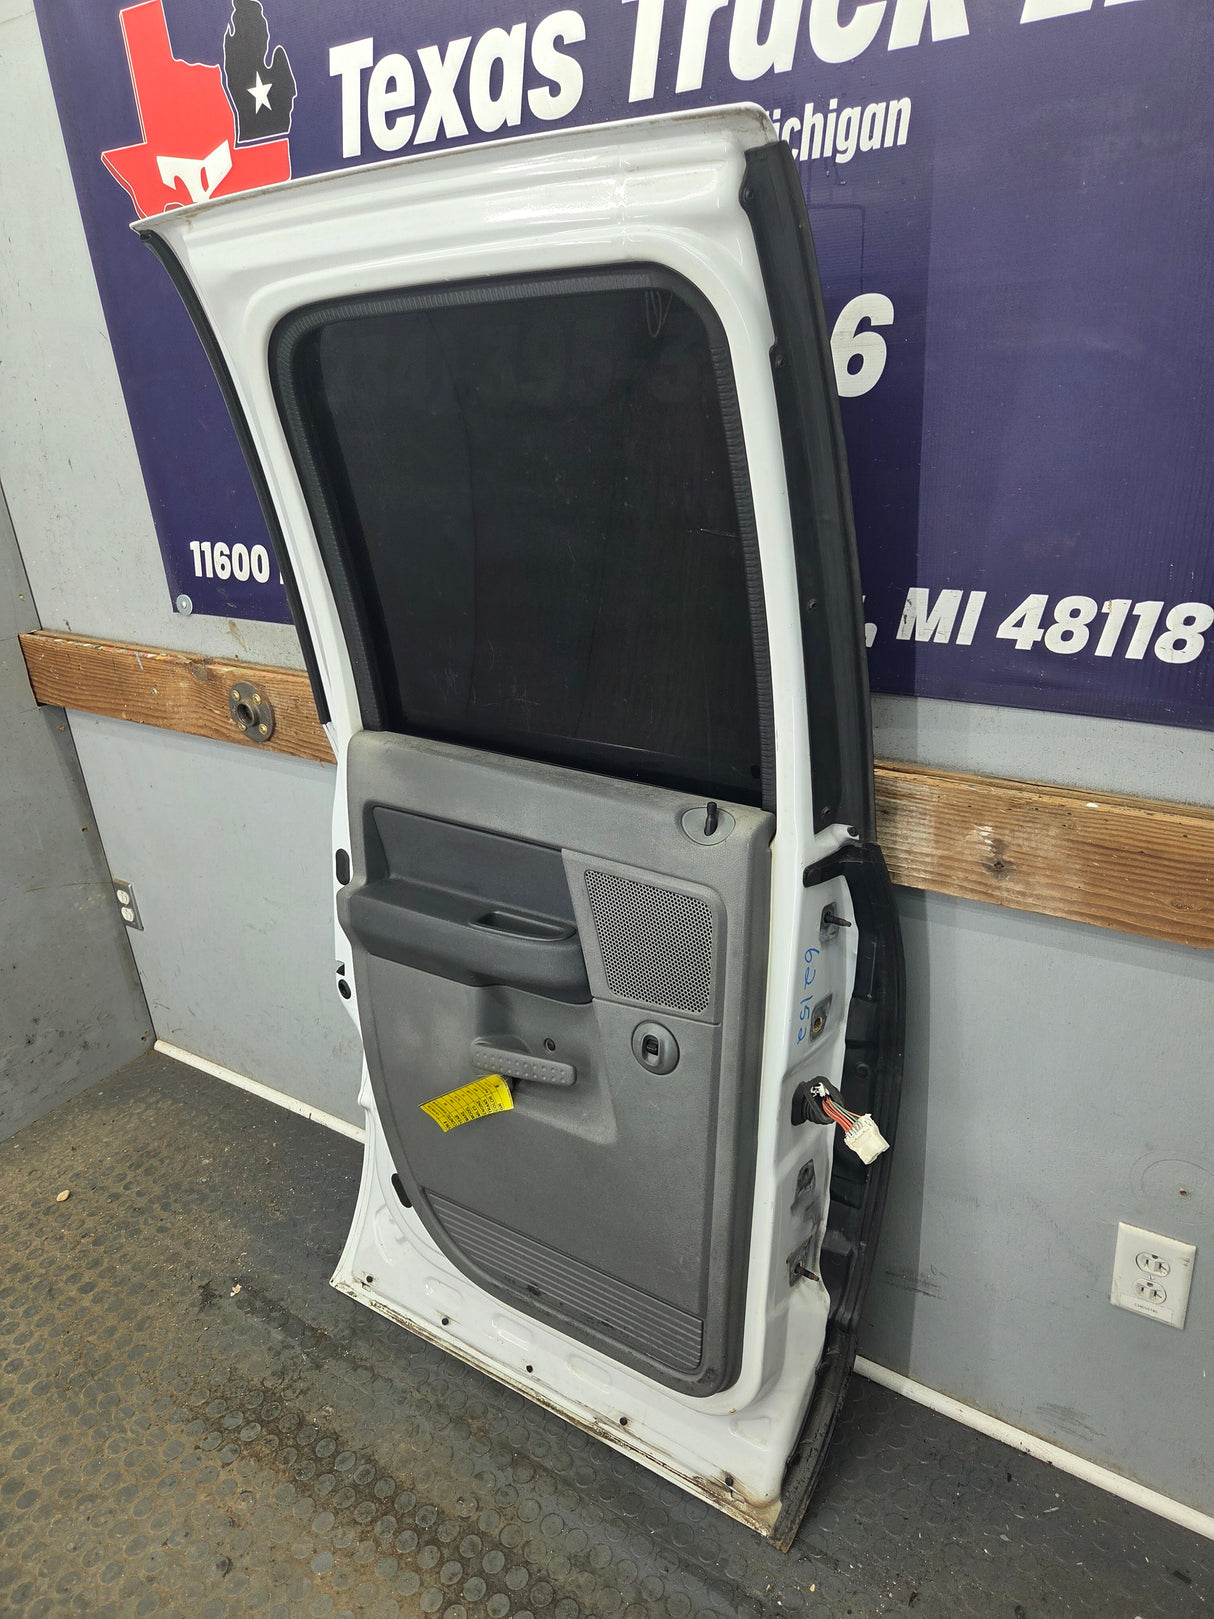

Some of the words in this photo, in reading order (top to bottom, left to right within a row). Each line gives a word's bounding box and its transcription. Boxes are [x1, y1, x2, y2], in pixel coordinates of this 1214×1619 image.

[329, 9, 586, 159] Texas
[765, 96, 912, 164] ichigan
[189, 540, 270, 584] 11600
[896, 587, 987, 646] MI
[996, 593, 1214, 664] 48118
[797, 947, 820, 1045] 62152
